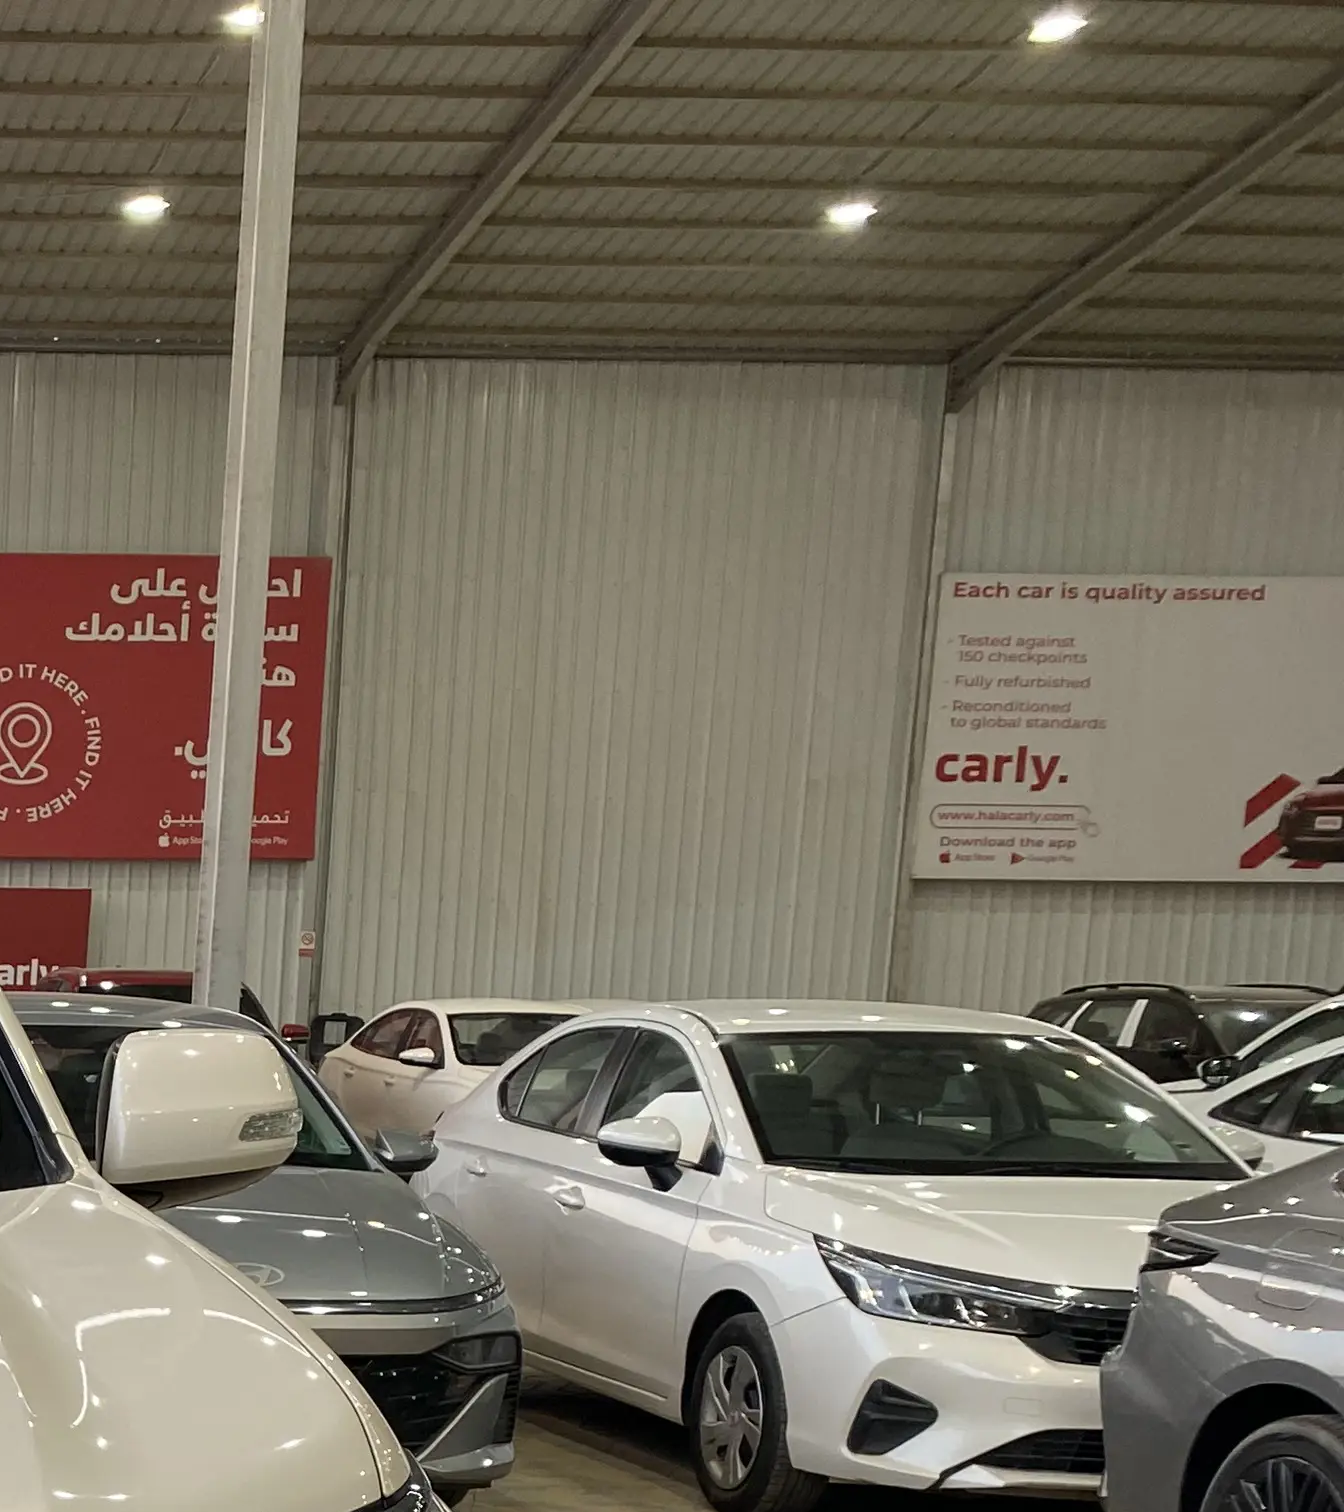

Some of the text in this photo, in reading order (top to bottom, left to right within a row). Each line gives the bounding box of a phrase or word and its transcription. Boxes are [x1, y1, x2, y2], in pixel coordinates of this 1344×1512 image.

[110, 567, 187, 605] على
[953, 581, 1267, 604] Each car is quality assured
[65, 600, 192, 642] أحلامك
[958, 634, 1076, 650] Tested against
[957, 650, 1088, 666] 150 checkpoints
[18, 663, 38, 679] IT
[40, 666, 89, 707] HERE
[955, 675, 1092, 690] Fully refurbished
[952, 699, 1072, 713] Reconditioned
[950, 716, 1108, 730] to global standards
[25, 716, 102, 823] FIND IT HERE
[935, 745, 1069, 792] carly.
[939, 836, 1077, 850] Download the app
